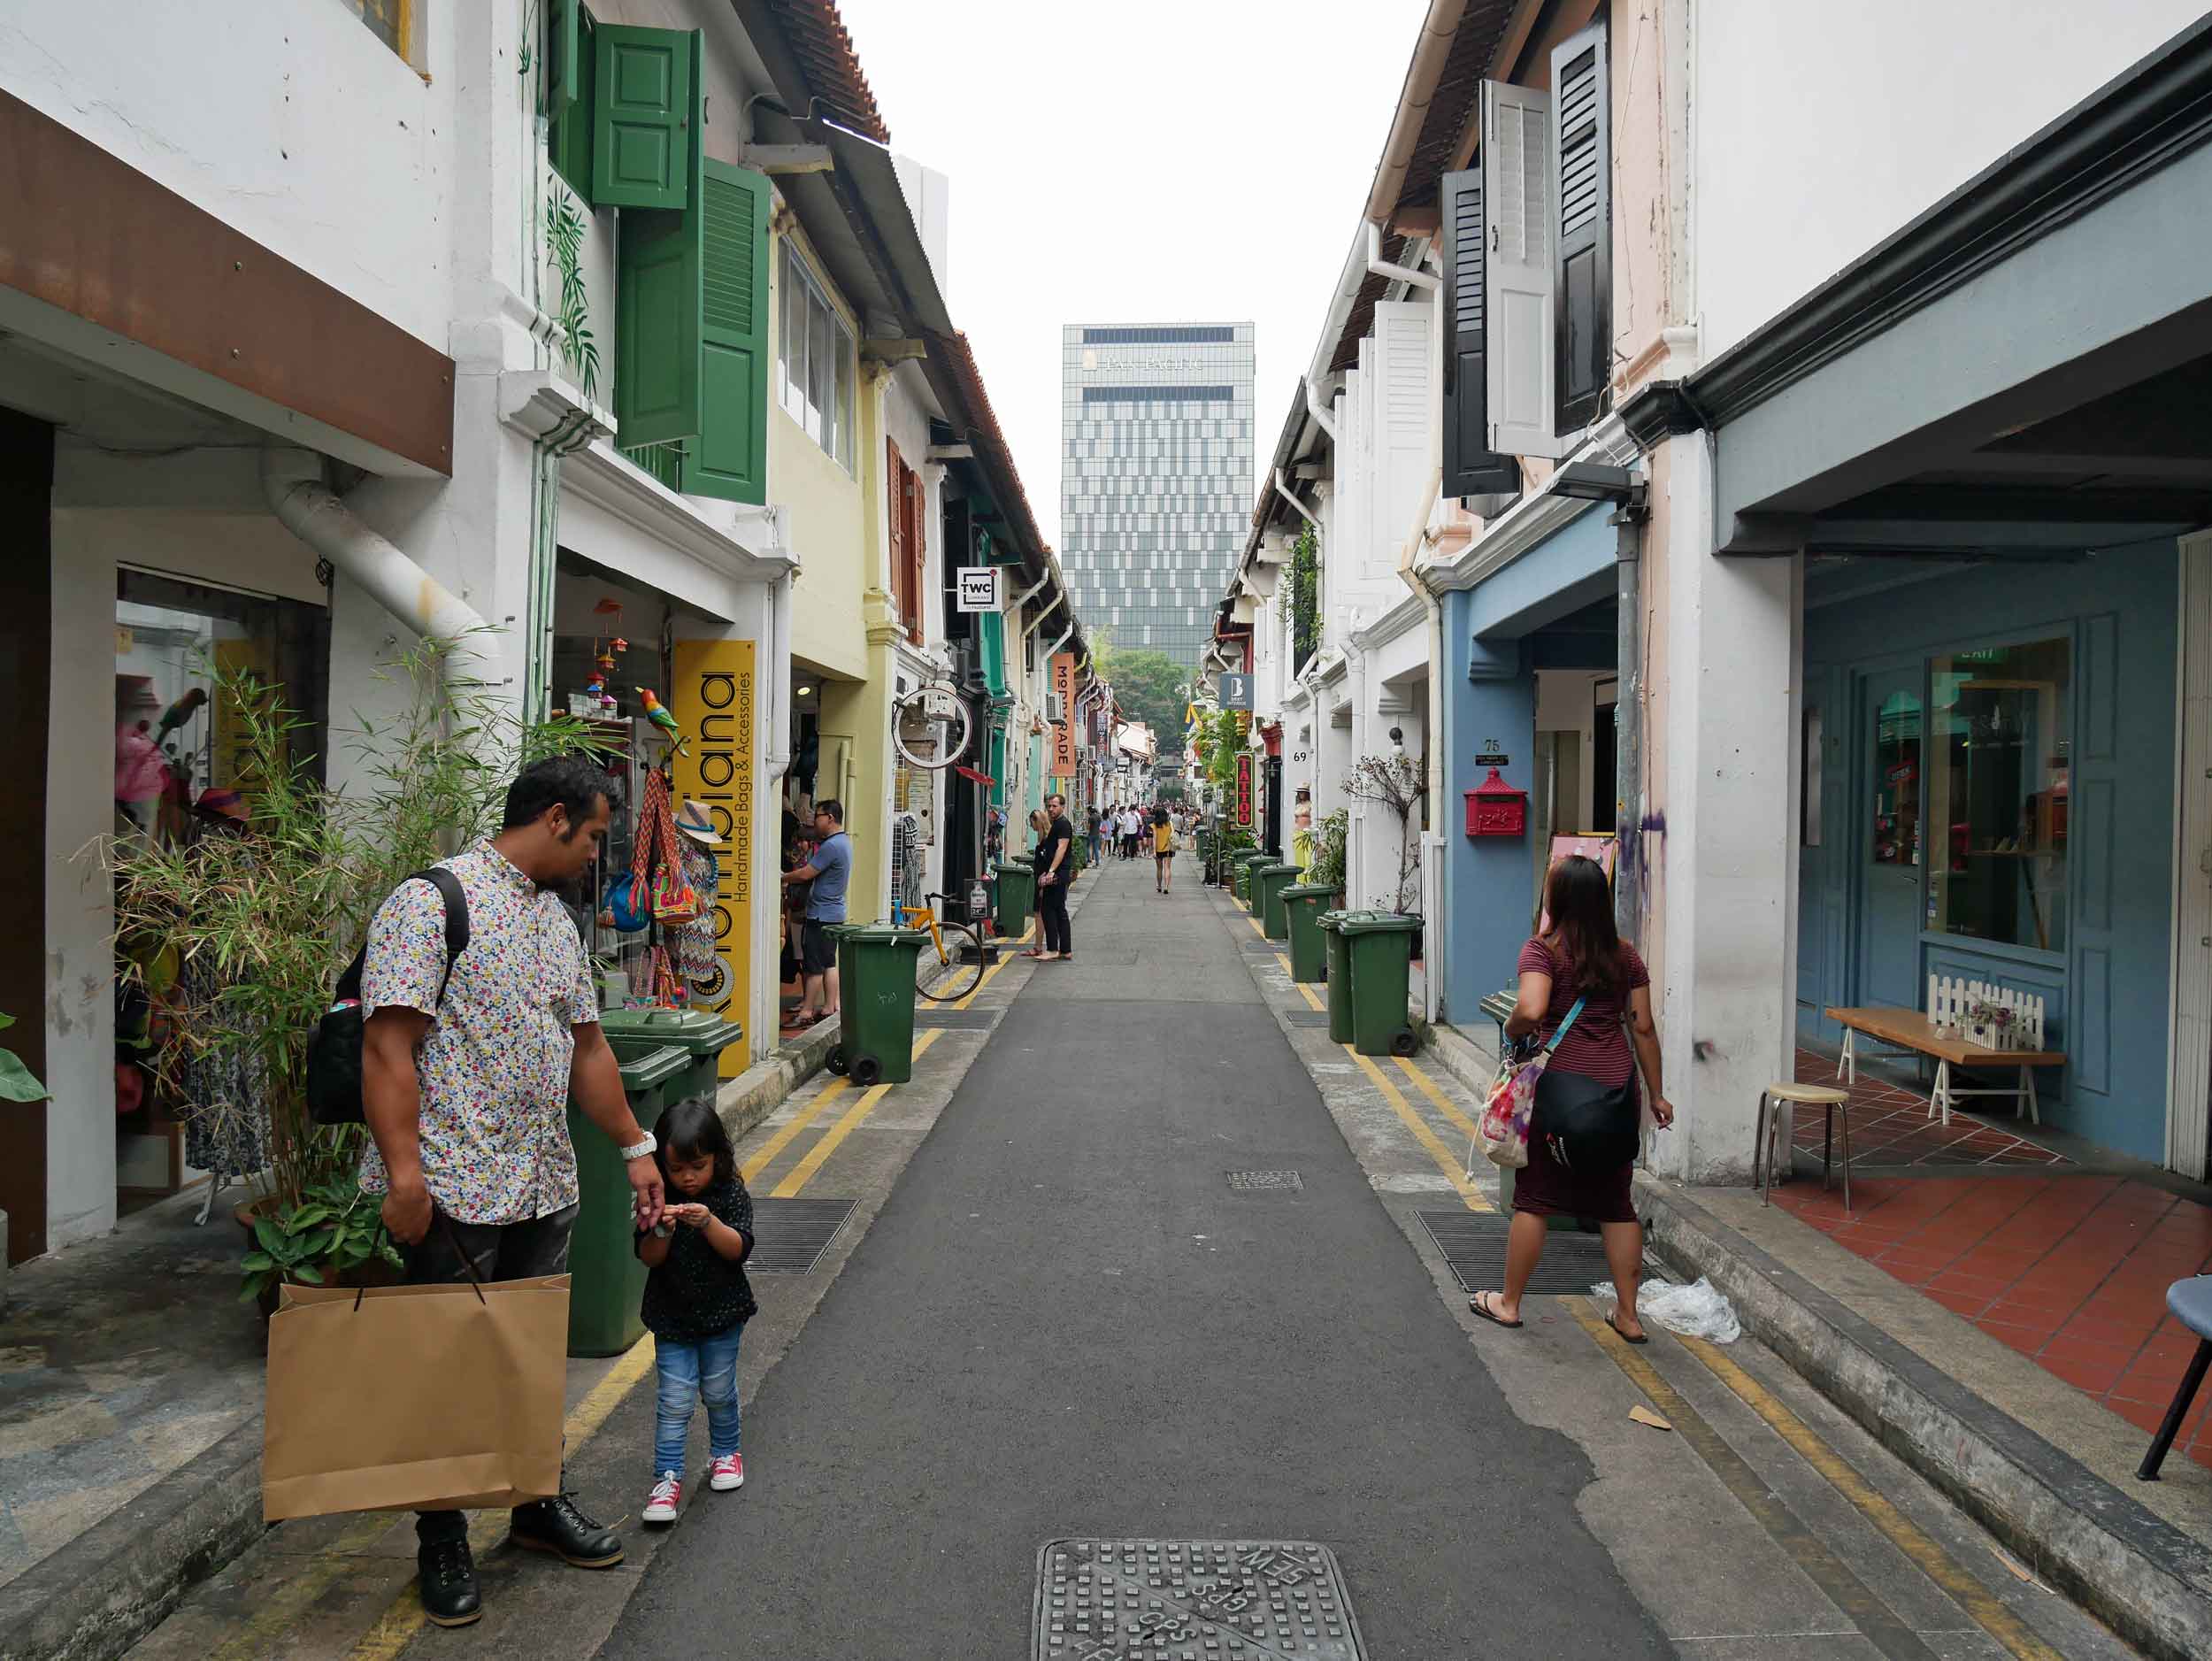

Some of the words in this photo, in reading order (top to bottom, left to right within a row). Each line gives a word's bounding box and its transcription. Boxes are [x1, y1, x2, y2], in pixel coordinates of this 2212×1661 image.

[961, 583, 991, 593] TWC
[736, 671, 751, 756] Accessories
[1294, 751, 1307, 762] 69
[1485, 739, 1501, 751] 75
[734, 758, 749, 772] &
[735, 771, 753, 819] Bags
[1239, 757, 1250, 824] TATTOO
[733, 819, 749, 903] Handmade
